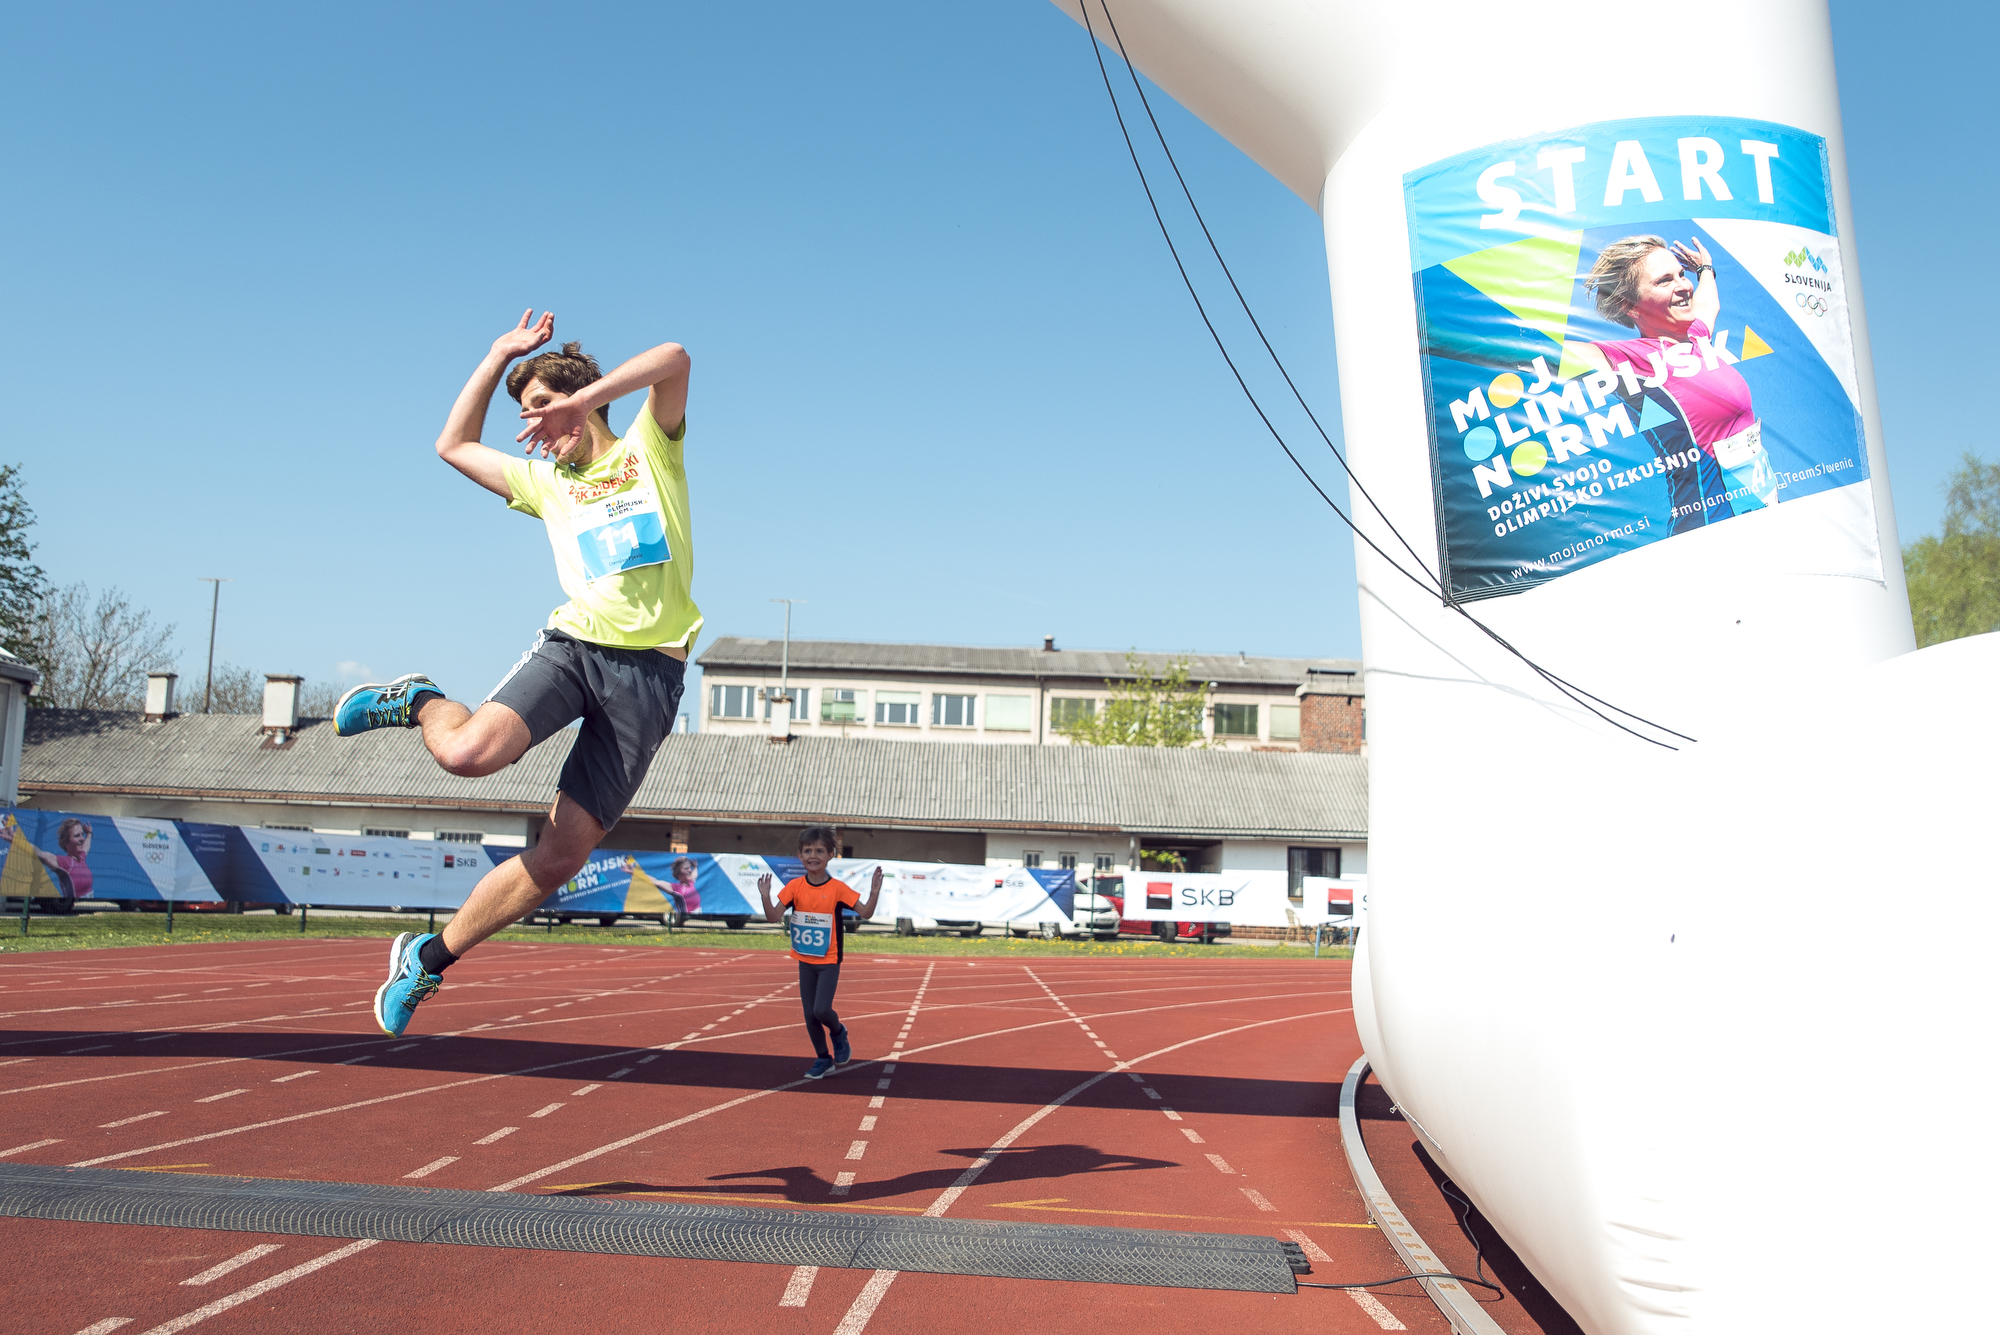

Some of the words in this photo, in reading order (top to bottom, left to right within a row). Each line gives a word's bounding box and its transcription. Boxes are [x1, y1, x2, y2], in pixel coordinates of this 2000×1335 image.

[1476, 137, 1779, 229] START
[1785, 273, 1832, 292] SLOVENIJA
[1487, 483, 1551, 521] DOŽIVI
[1552, 458, 1612, 490] SVOJO
[1494, 482, 1603, 538] OLIMPIJSKO
[1607, 447, 1701, 490] IZKUŠNJO
[1670, 483, 1760, 519] #mojanorma
[597, 521, 640, 557] 11
[1510, 515, 1651, 580] www.mojanorma.si
[457, 858, 478, 867] SKB
[1005, 879, 1024, 888] SKB
[1181, 888, 1234, 906] SKB
[793, 927, 825, 947] 263
